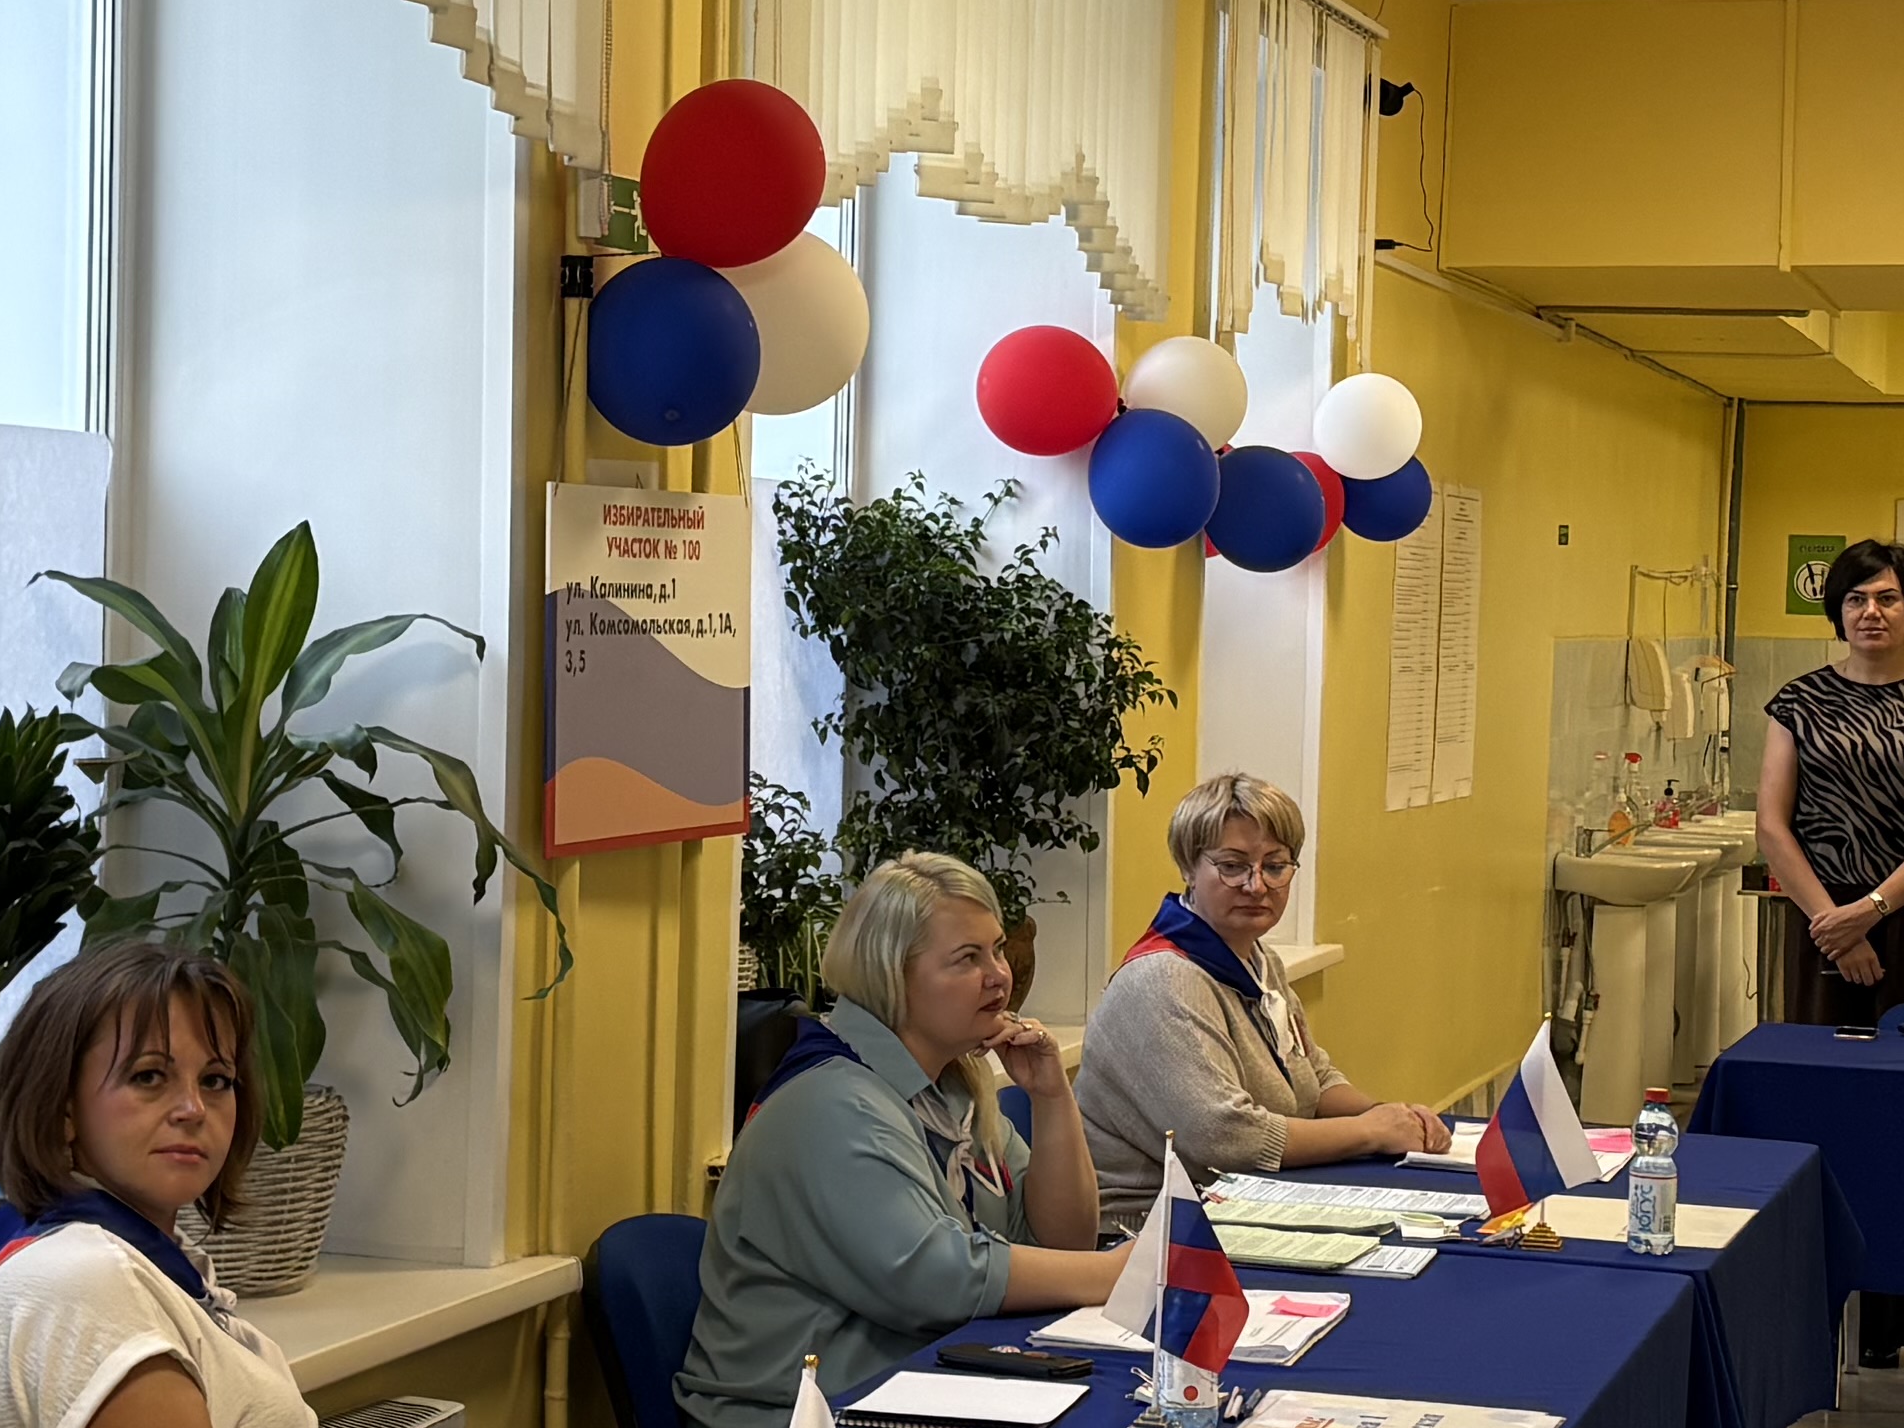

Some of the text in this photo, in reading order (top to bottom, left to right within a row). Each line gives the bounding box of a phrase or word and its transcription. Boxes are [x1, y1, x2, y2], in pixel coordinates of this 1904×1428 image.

[603, 504, 704, 530] ИЗБИРАТЕЛЬНЫЙ
[607, 536, 700, 561] УЧАСТОК № 100
[566, 581, 584, 604] ул.
[566, 619, 584, 642] ул.
